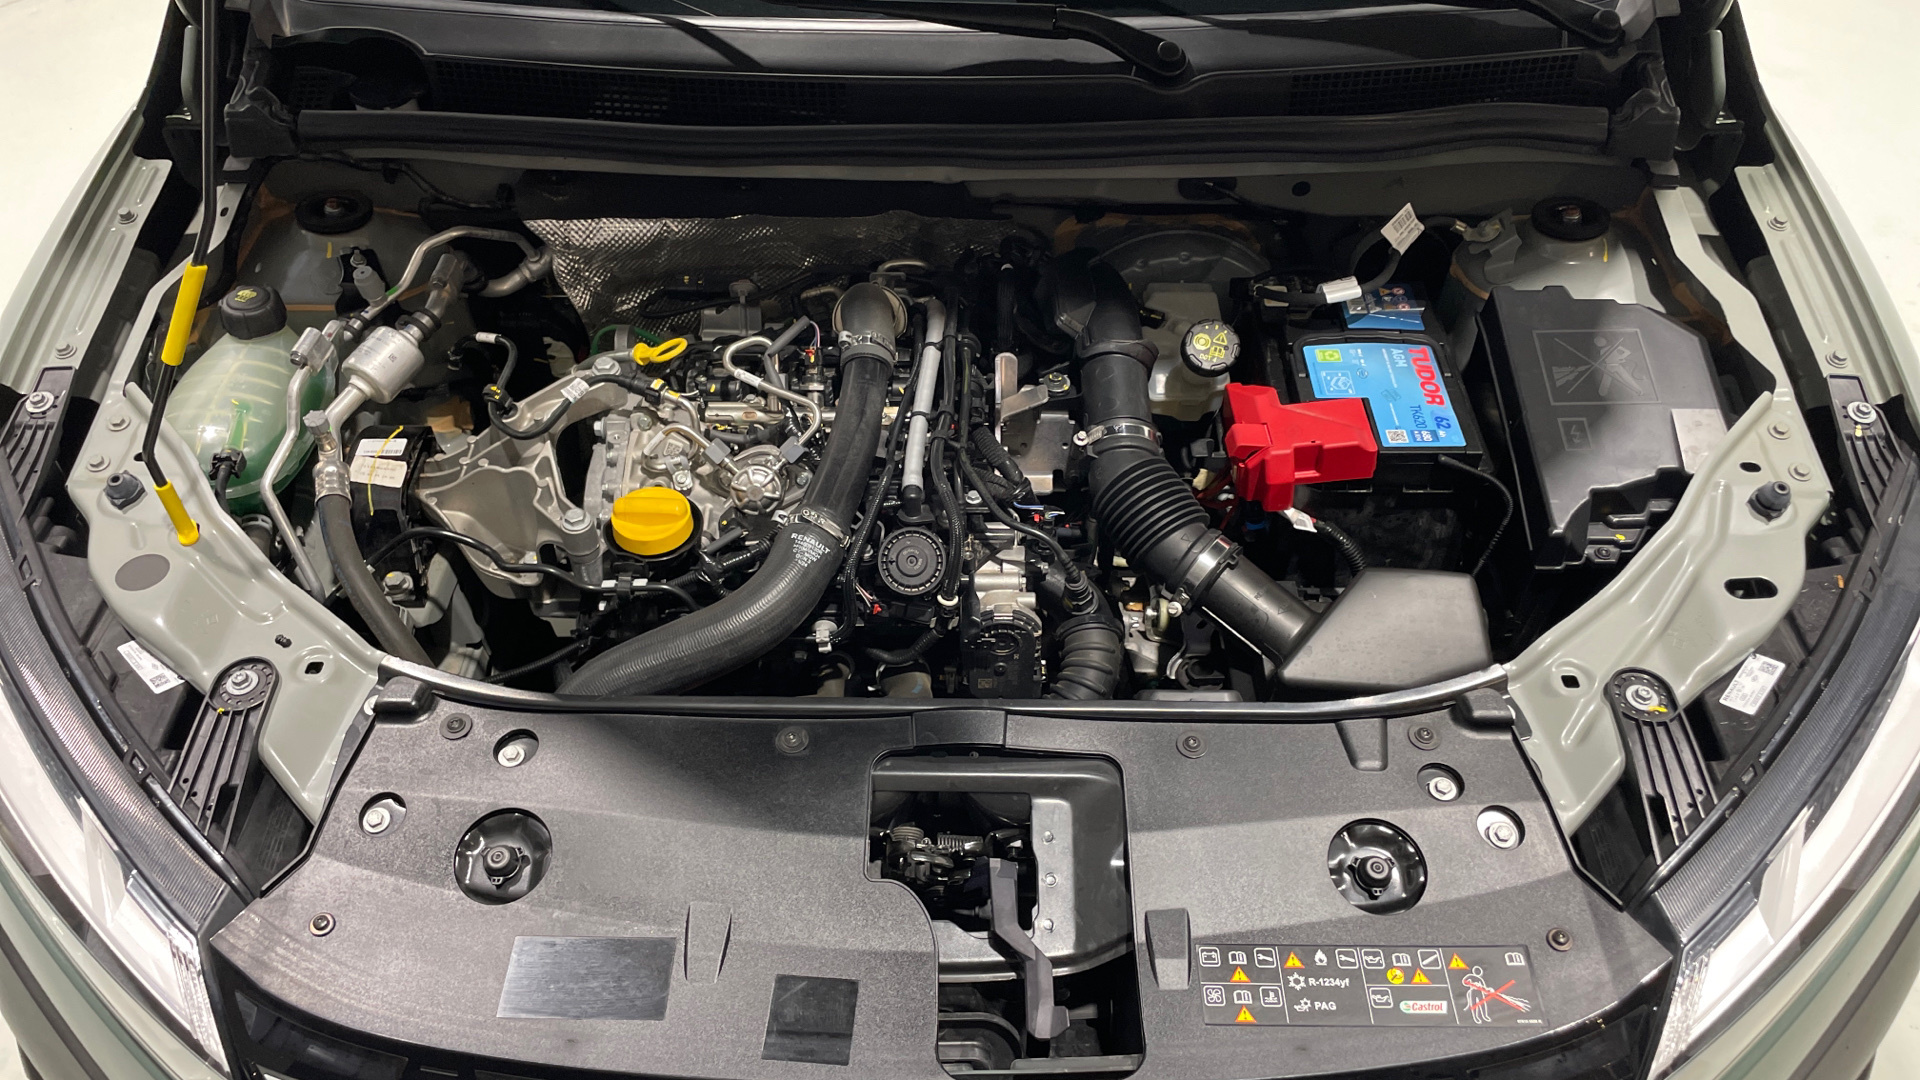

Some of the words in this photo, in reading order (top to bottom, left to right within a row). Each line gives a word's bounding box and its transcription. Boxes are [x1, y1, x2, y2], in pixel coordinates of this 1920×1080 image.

[1390, 349, 1408, 367] AGM
[1408, 347, 1446, 406] TUDOR
[1410, 405, 1428, 429] TK620
[1434, 416, 1451, 429] 62
[791, 533, 830, 554] RENAULT
[1722, 680, 1739, 702] RENAULT
[1308, 977, 1350, 989] R-1234yf
[1314, 1001, 1337, 1011] PAG
[1411, 1002, 1443, 1012] Castrol
